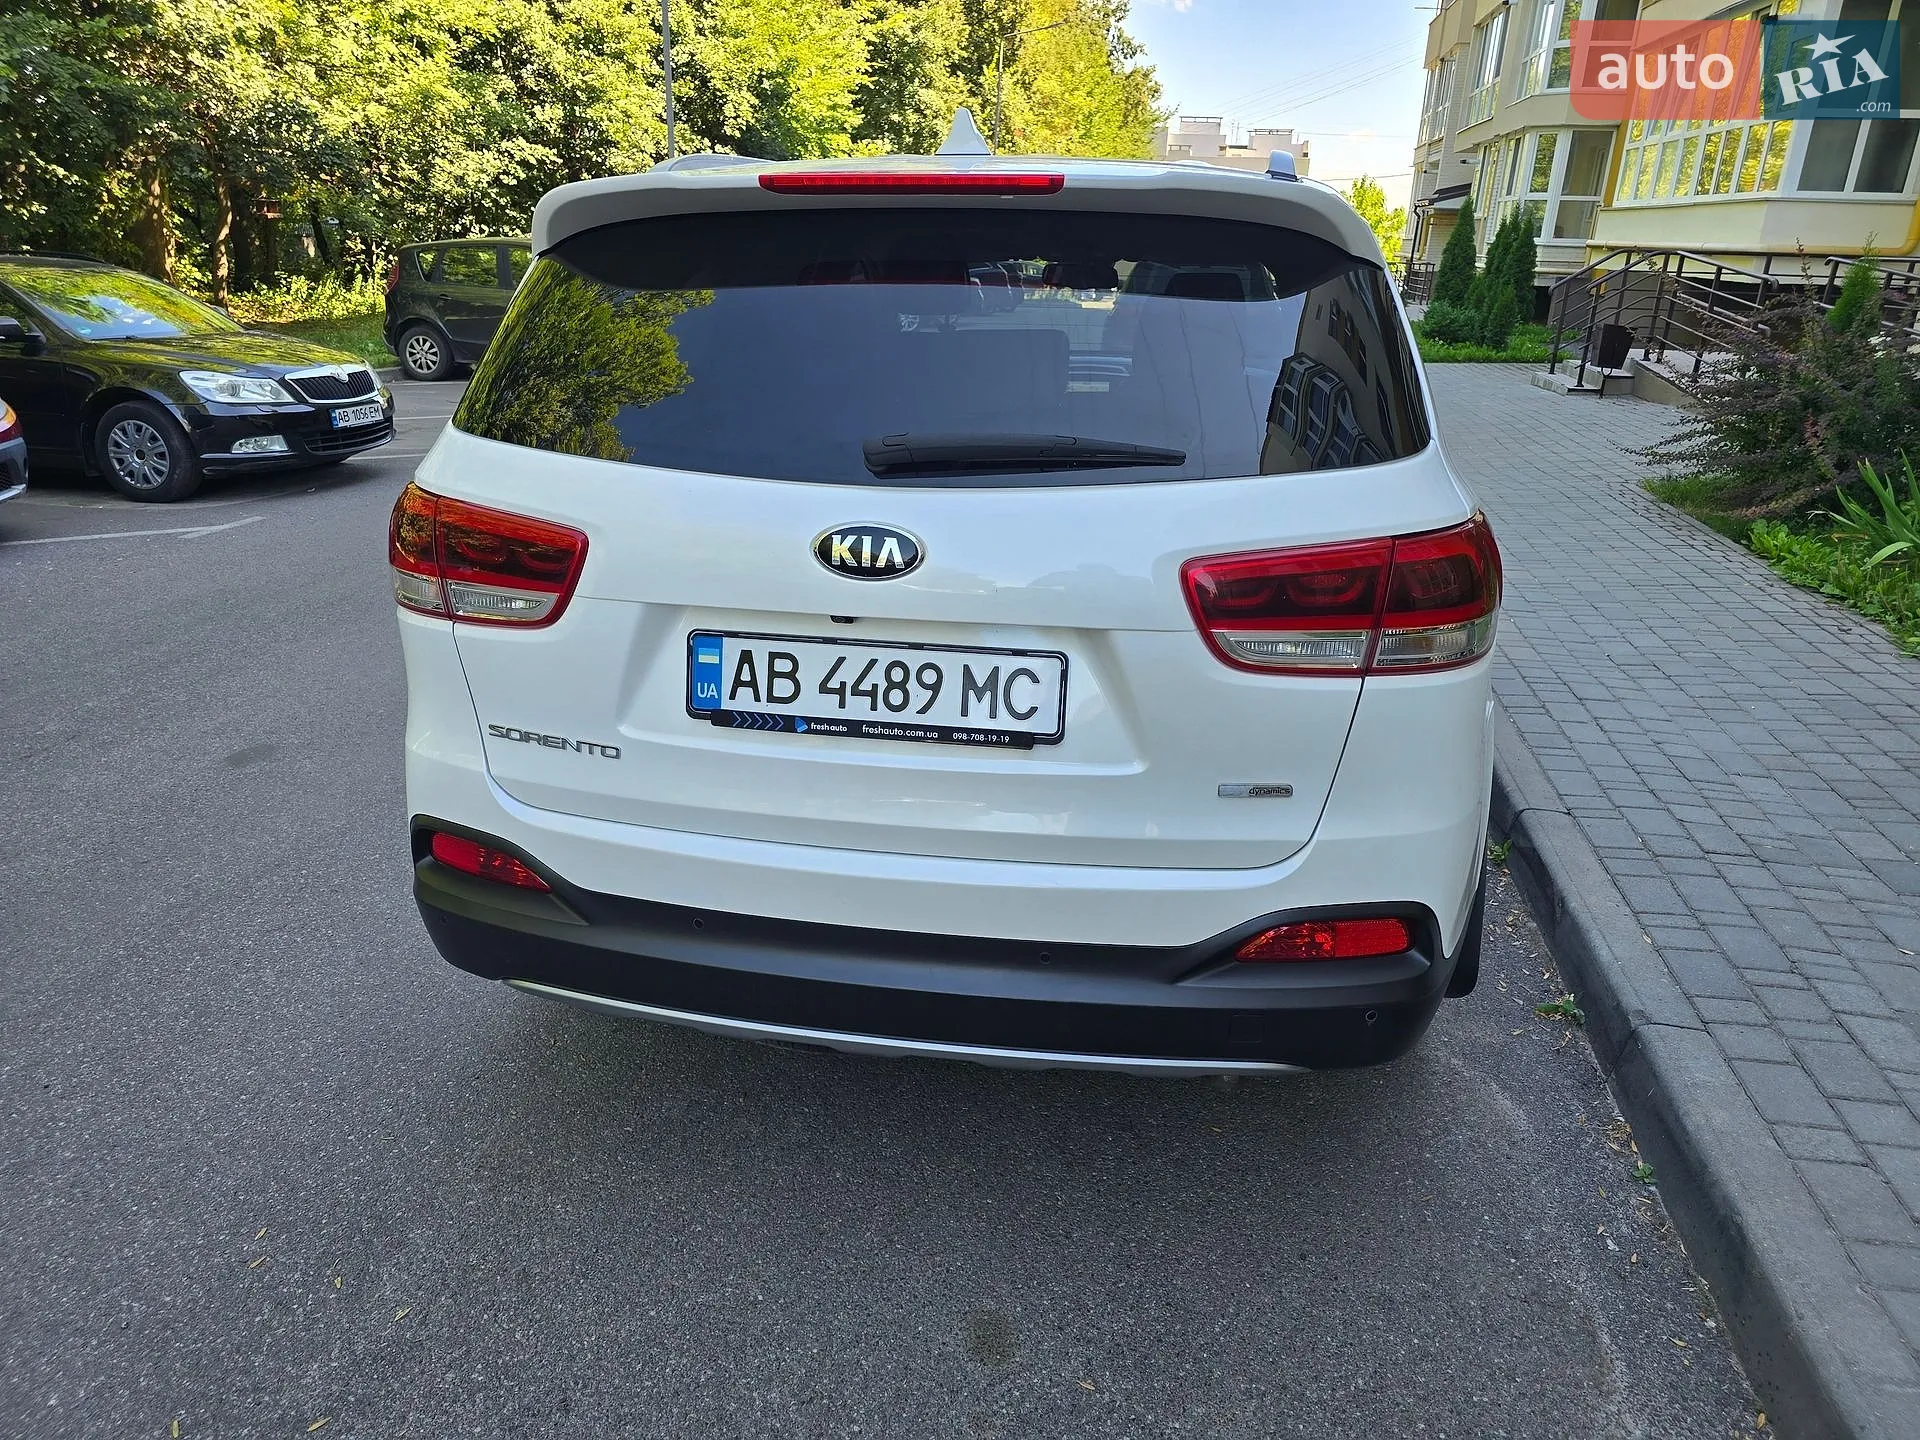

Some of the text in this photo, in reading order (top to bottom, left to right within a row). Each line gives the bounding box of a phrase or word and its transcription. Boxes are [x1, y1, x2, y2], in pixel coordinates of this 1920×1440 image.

[338, 411, 350, 423] AB
[352, 409, 369, 421] 1056
[369, 405, 380, 418] EM
[831, 534, 905, 569] KIA
[697, 682, 718, 699] UA
[728, 649, 1040, 721] AB 4489 MC
[488, 723, 622, 760] SORENTO
[810, 722, 1010, 743] freshauto freshauto.com.ua 098-708-19-19
